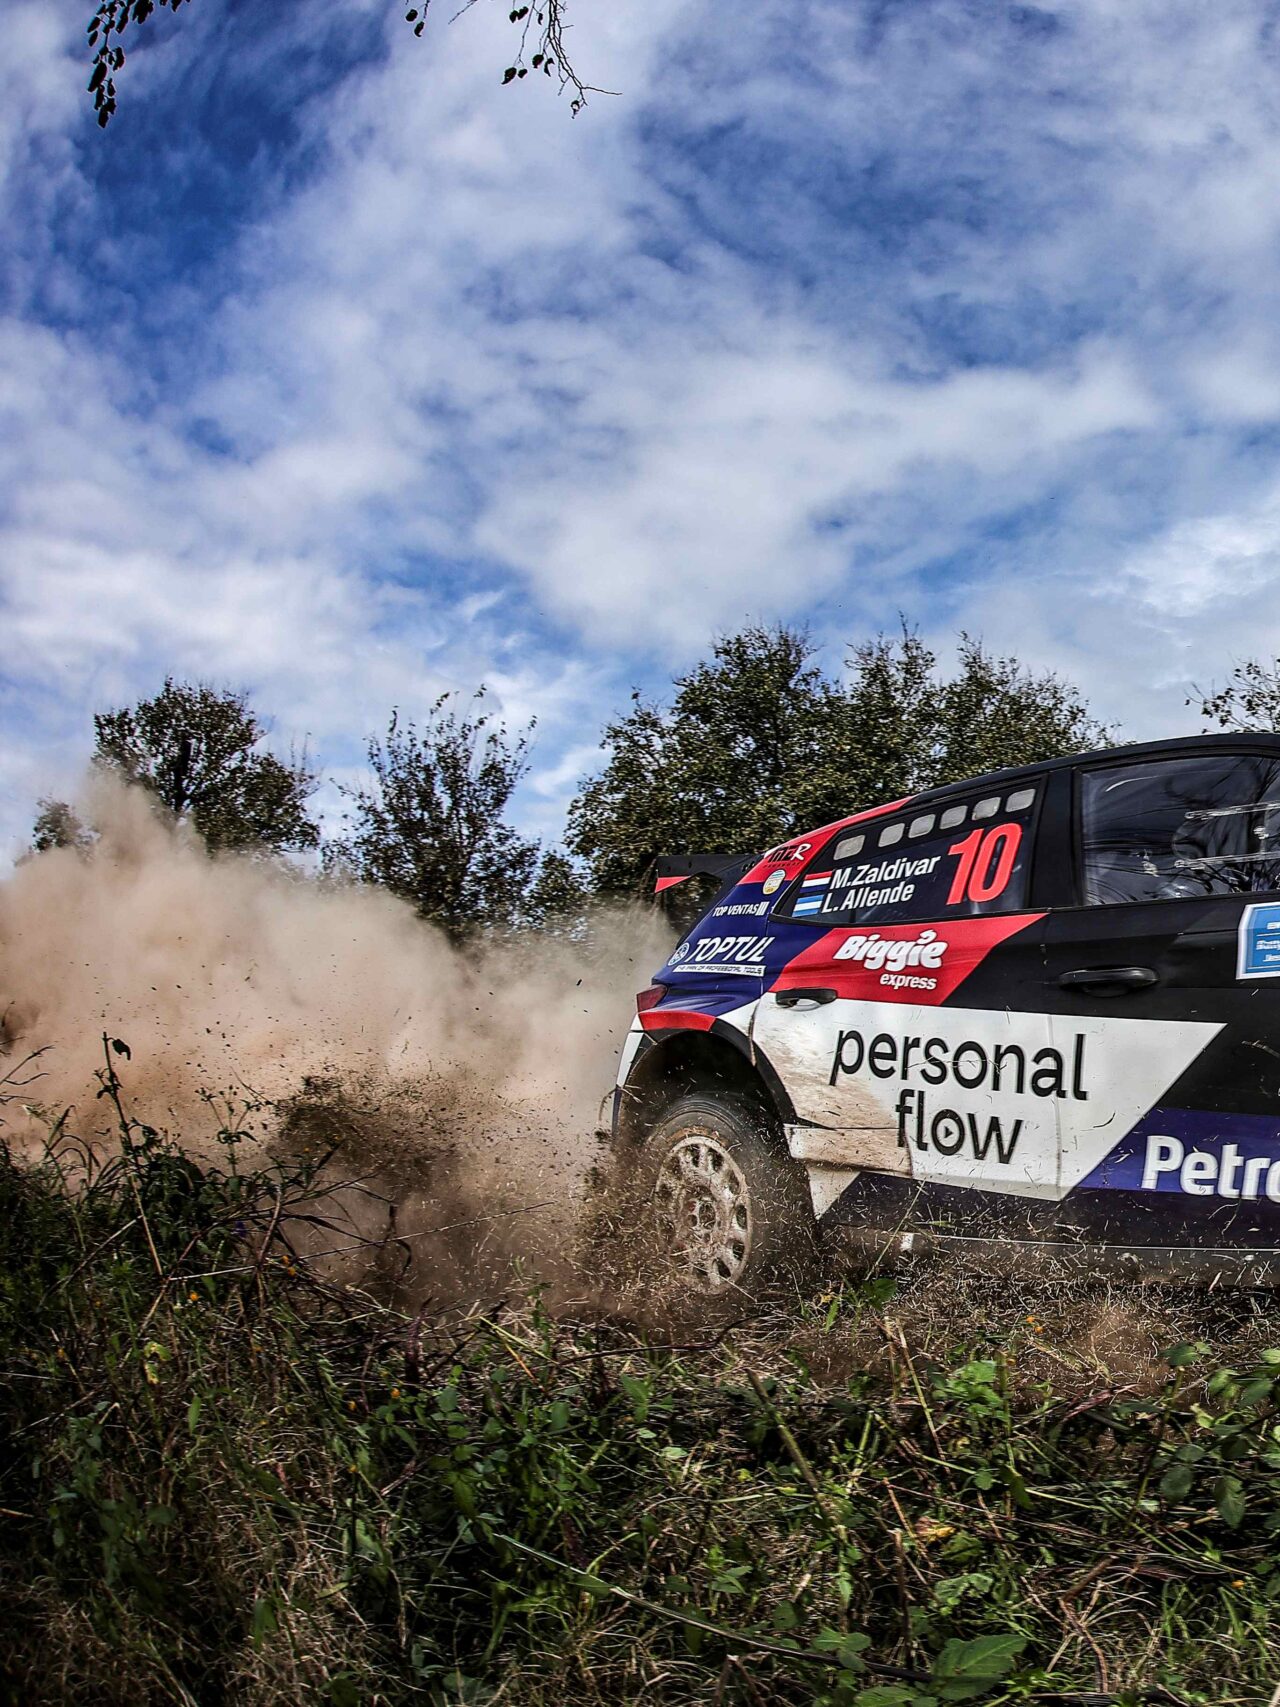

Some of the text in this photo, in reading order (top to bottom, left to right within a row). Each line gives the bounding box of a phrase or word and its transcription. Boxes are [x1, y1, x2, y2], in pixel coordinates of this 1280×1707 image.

[829, 855, 941, 889] M.Zaldivar
[946, 822, 1022, 905] 10
[712, 903, 758, 917] TOP VENTAS
[821, 882, 915, 913] L. Allende
[684, 936, 775, 963] TOPTUL
[833, 929, 949, 972] Biggie
[879, 972, 938, 990] express
[828, 1029, 1089, 1101] personal
[895, 1088, 1025, 1165] flow
